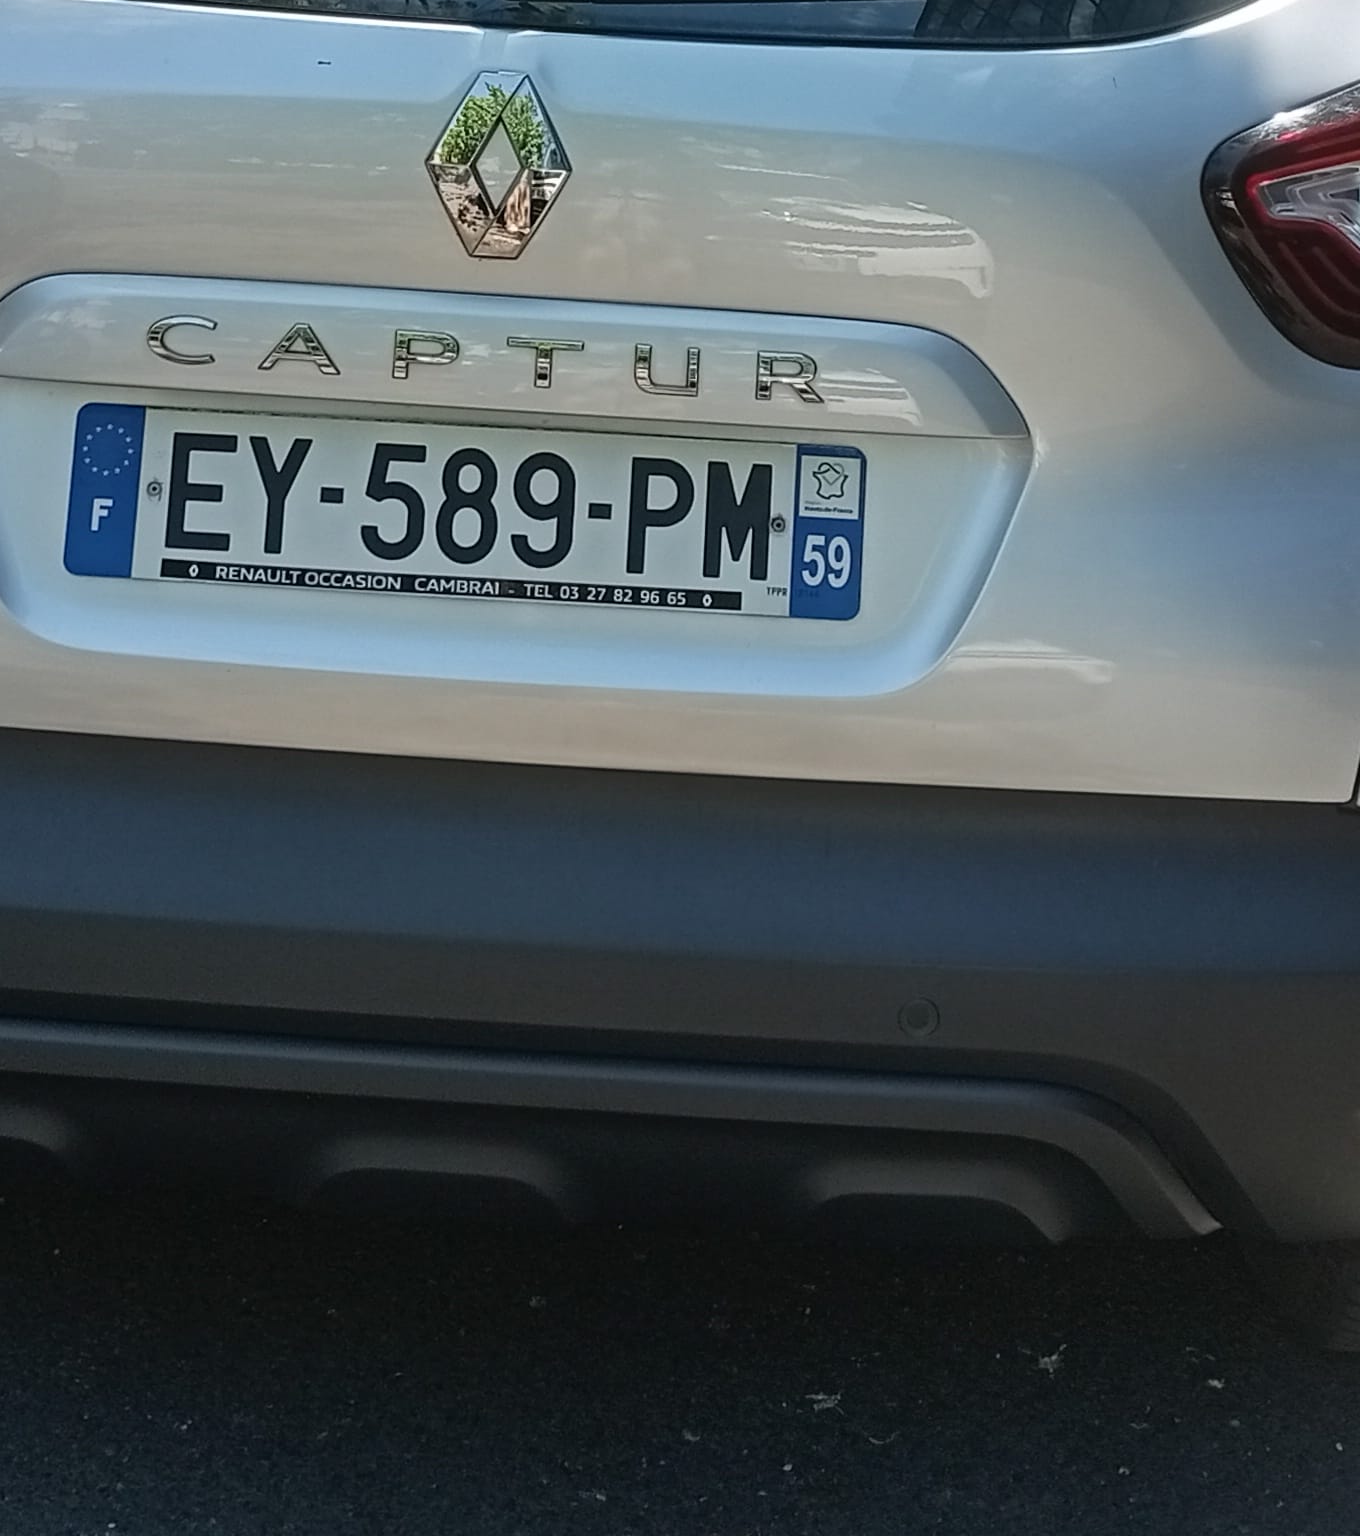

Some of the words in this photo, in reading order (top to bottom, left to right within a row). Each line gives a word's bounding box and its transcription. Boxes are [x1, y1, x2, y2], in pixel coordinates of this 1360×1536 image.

[145, 314, 825, 405] CAPTUR
[90, 497, 113, 531] F
[163, 430, 773, 582] EY-589-PM
[215, 566, 302, 585] RENAULT
[304, 570, 402, 591] OCCASION
[413, 577, 501, 597] CAMBRAI
[524, 583, 555, 600] TEL
[559, 586, 581, 601] 03
[586, 587, 608, 602] 27
[613, 589, 634, 604] 82
[639, 591, 661, 605] 96
[666, 592, 688, 606] 65
[801, 534, 852, 589] 59
